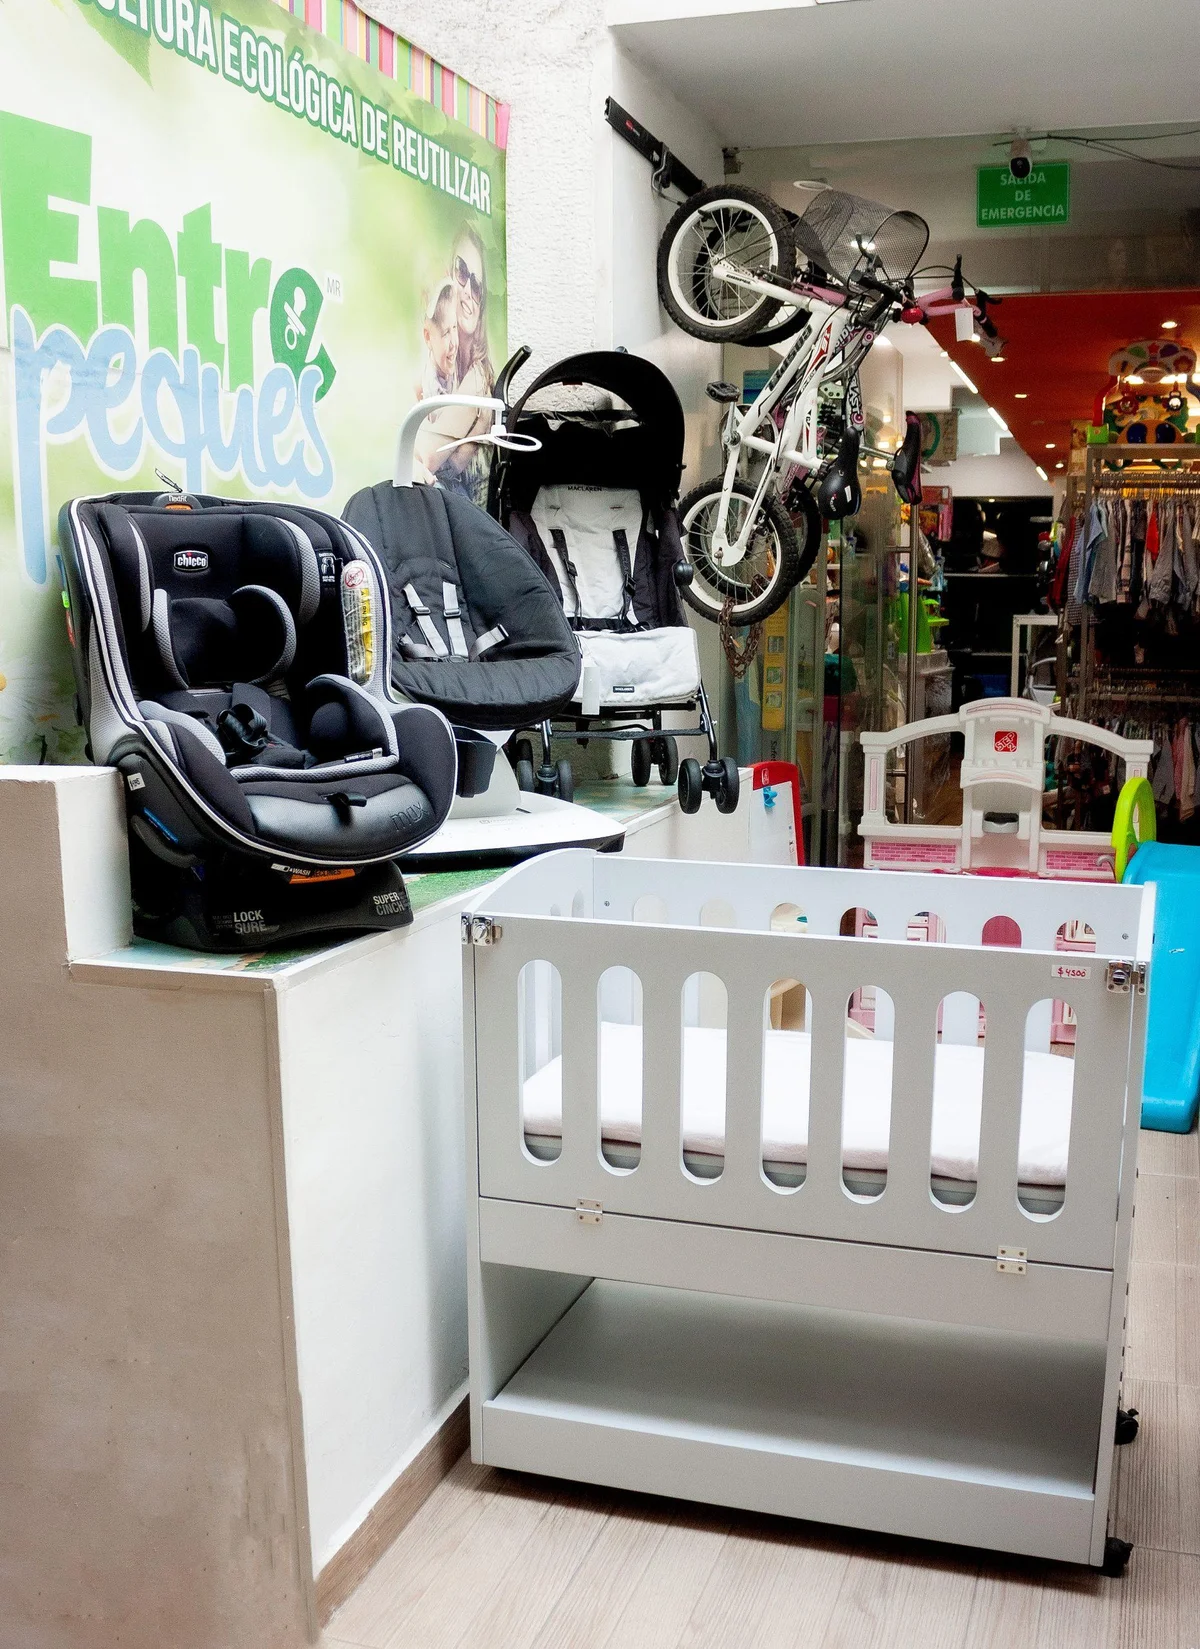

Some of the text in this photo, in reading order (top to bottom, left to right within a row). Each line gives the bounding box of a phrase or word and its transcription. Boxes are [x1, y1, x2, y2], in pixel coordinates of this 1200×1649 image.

[221, 17, 358, 144] ECOLÓGICA
[361, 100, 389, 160] DE
[392, 118, 492, 216] REUTILIZAR
[1014, 189, 1032, 202] DE
[981, 204, 1065, 220] EMERGENCIA
[10, 305, 334, 586] peques
[177, 553, 207, 567] chicco
[995, 732, 1015, 751] STEP
[372, 892, 400, 905] SUPER
[233, 909, 264, 922] LOCK
[376, 900, 405, 916] CINCH
[234, 920, 268, 935] SURE
